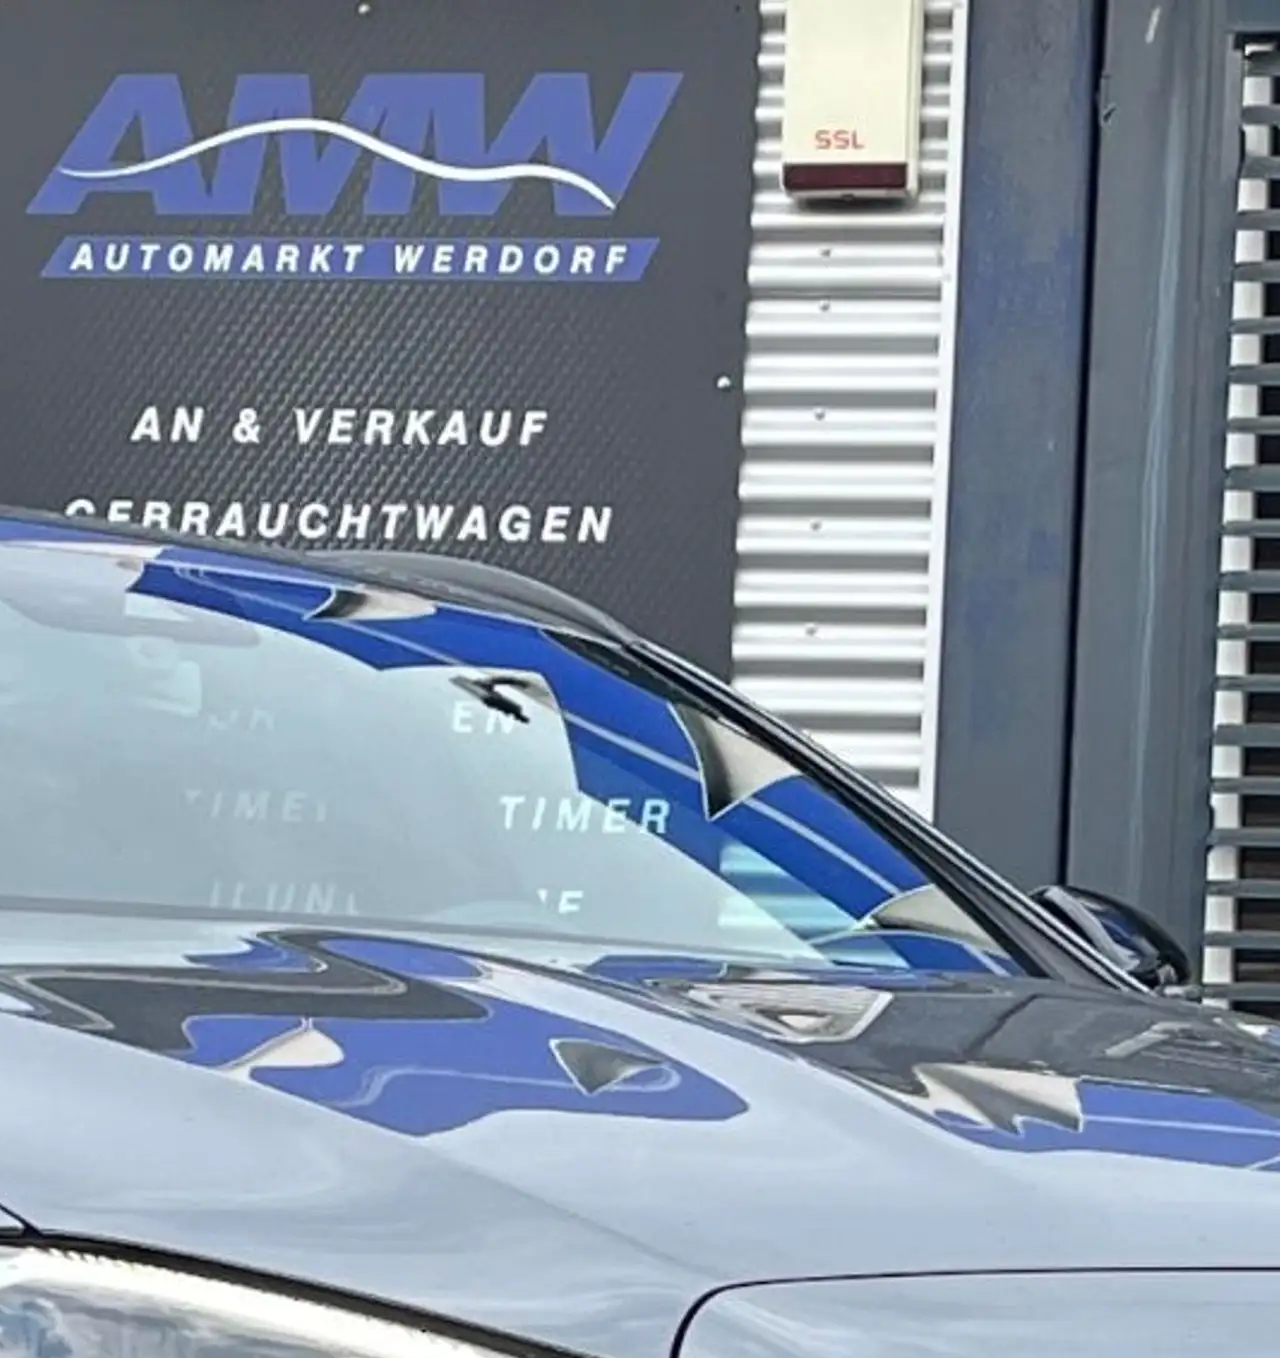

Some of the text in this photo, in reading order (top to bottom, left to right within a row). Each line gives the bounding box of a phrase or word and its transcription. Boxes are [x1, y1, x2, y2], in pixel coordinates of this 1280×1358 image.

[25, 72, 684, 216] AMW
[814, 128, 866, 150] SSL
[69, 243, 630, 276] AUTOMARKT WERDORF
[130, 406, 548, 446] AN & VERKAUF
